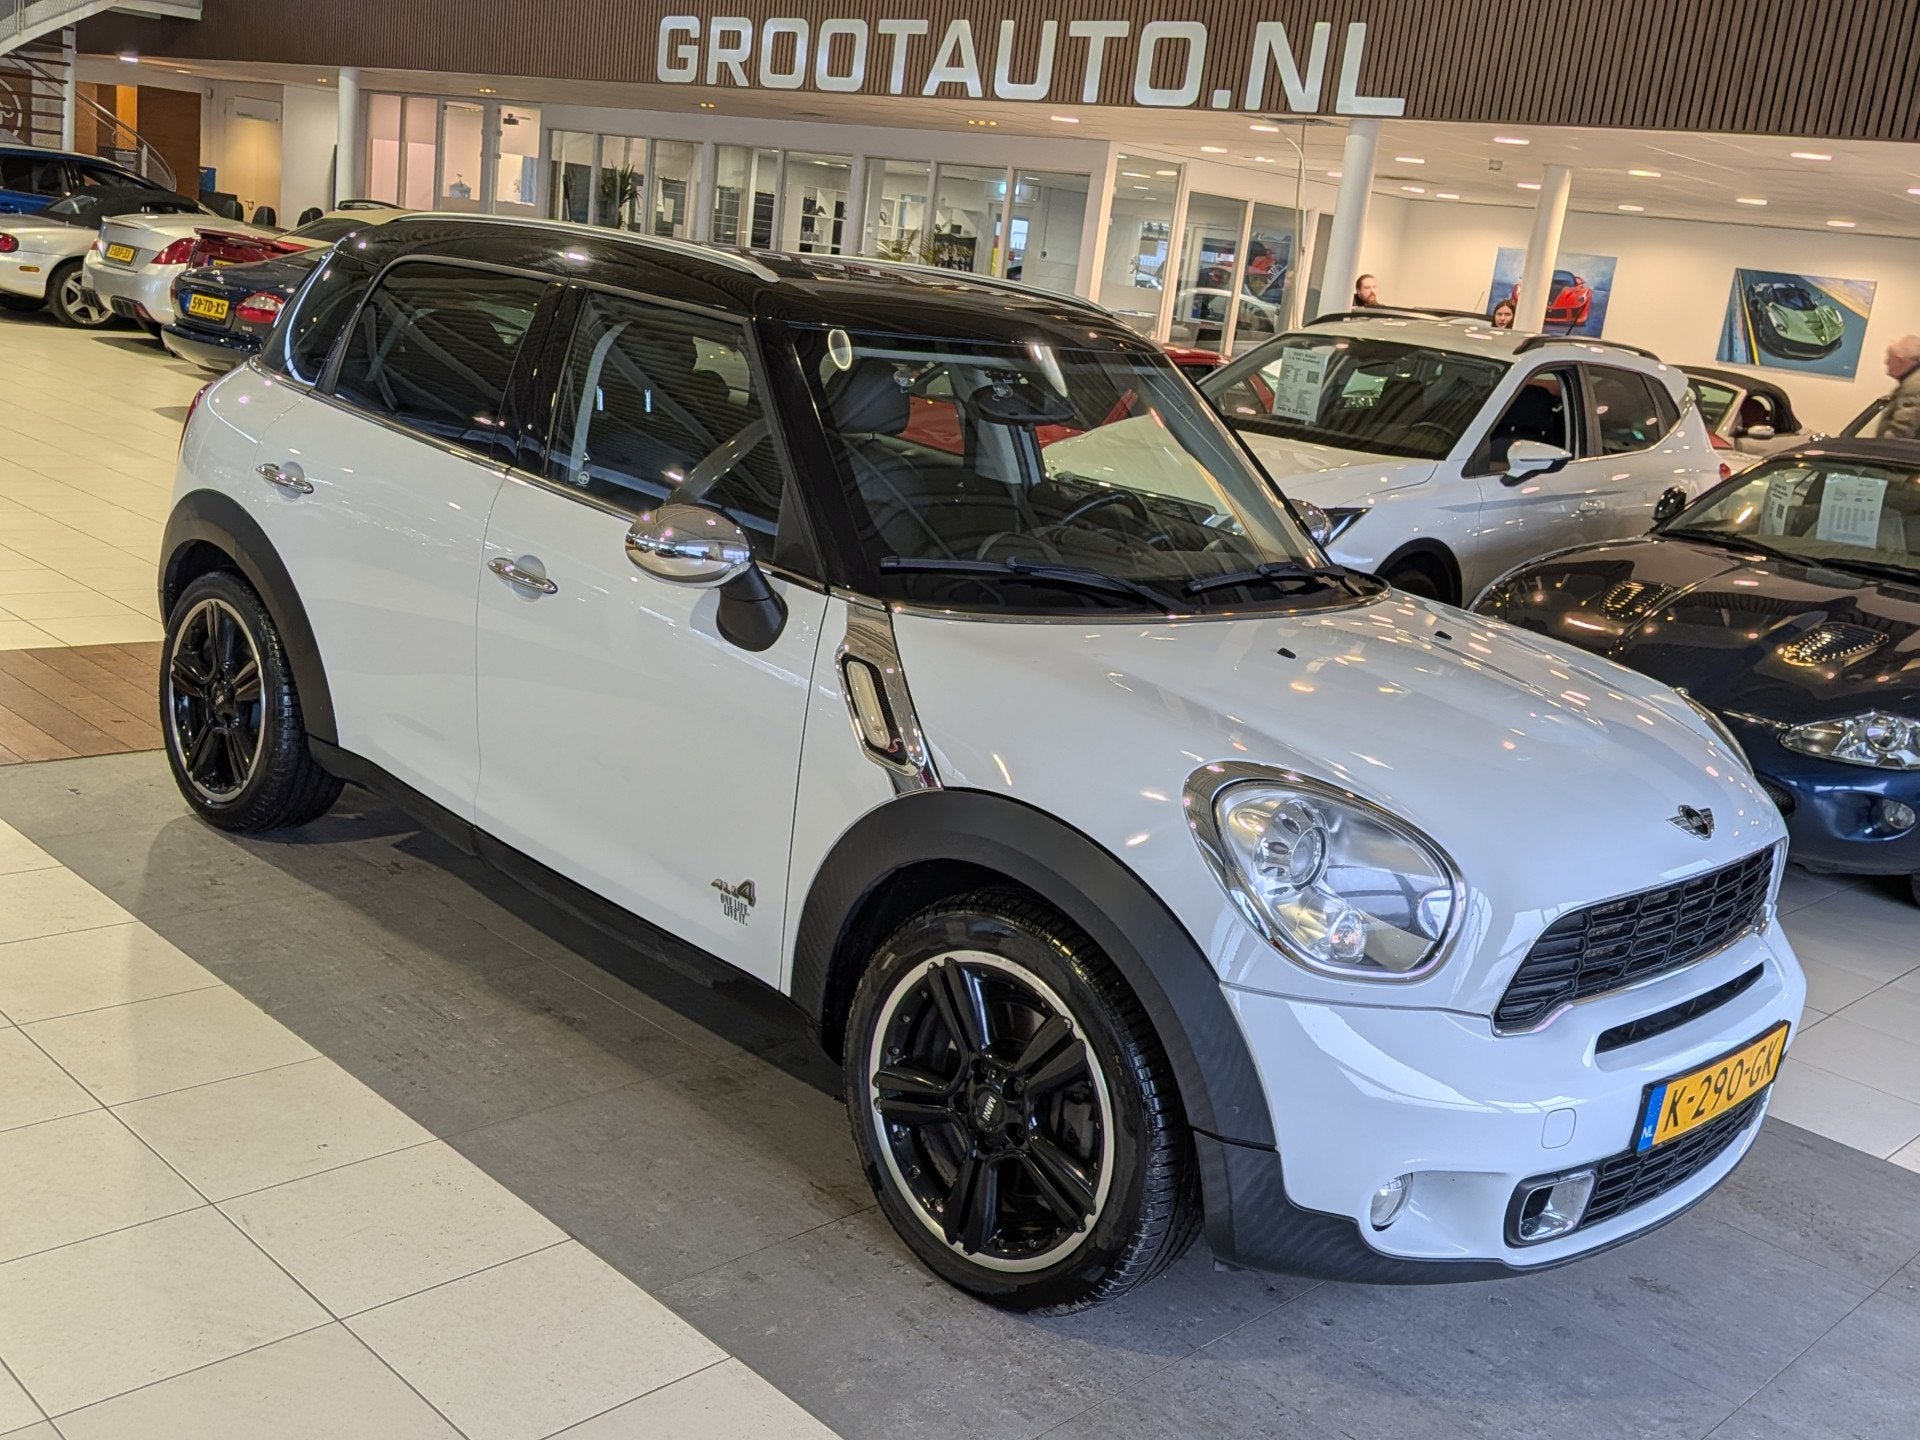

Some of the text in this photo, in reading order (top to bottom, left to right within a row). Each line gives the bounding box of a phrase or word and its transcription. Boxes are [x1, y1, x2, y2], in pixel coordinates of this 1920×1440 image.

[657, 15, 1406, 117] GROOTAUTO.NL
[191, 296, 227, 316] 59-TD-XS
[710, 878, 757, 908] ALL4
[720, 892, 733, 908] ONE
[723, 903, 738, 922] LIVE
[1640, 1036, 1780, 1140] NL K-290-GK
[981, 1094, 997, 1122] MINI
